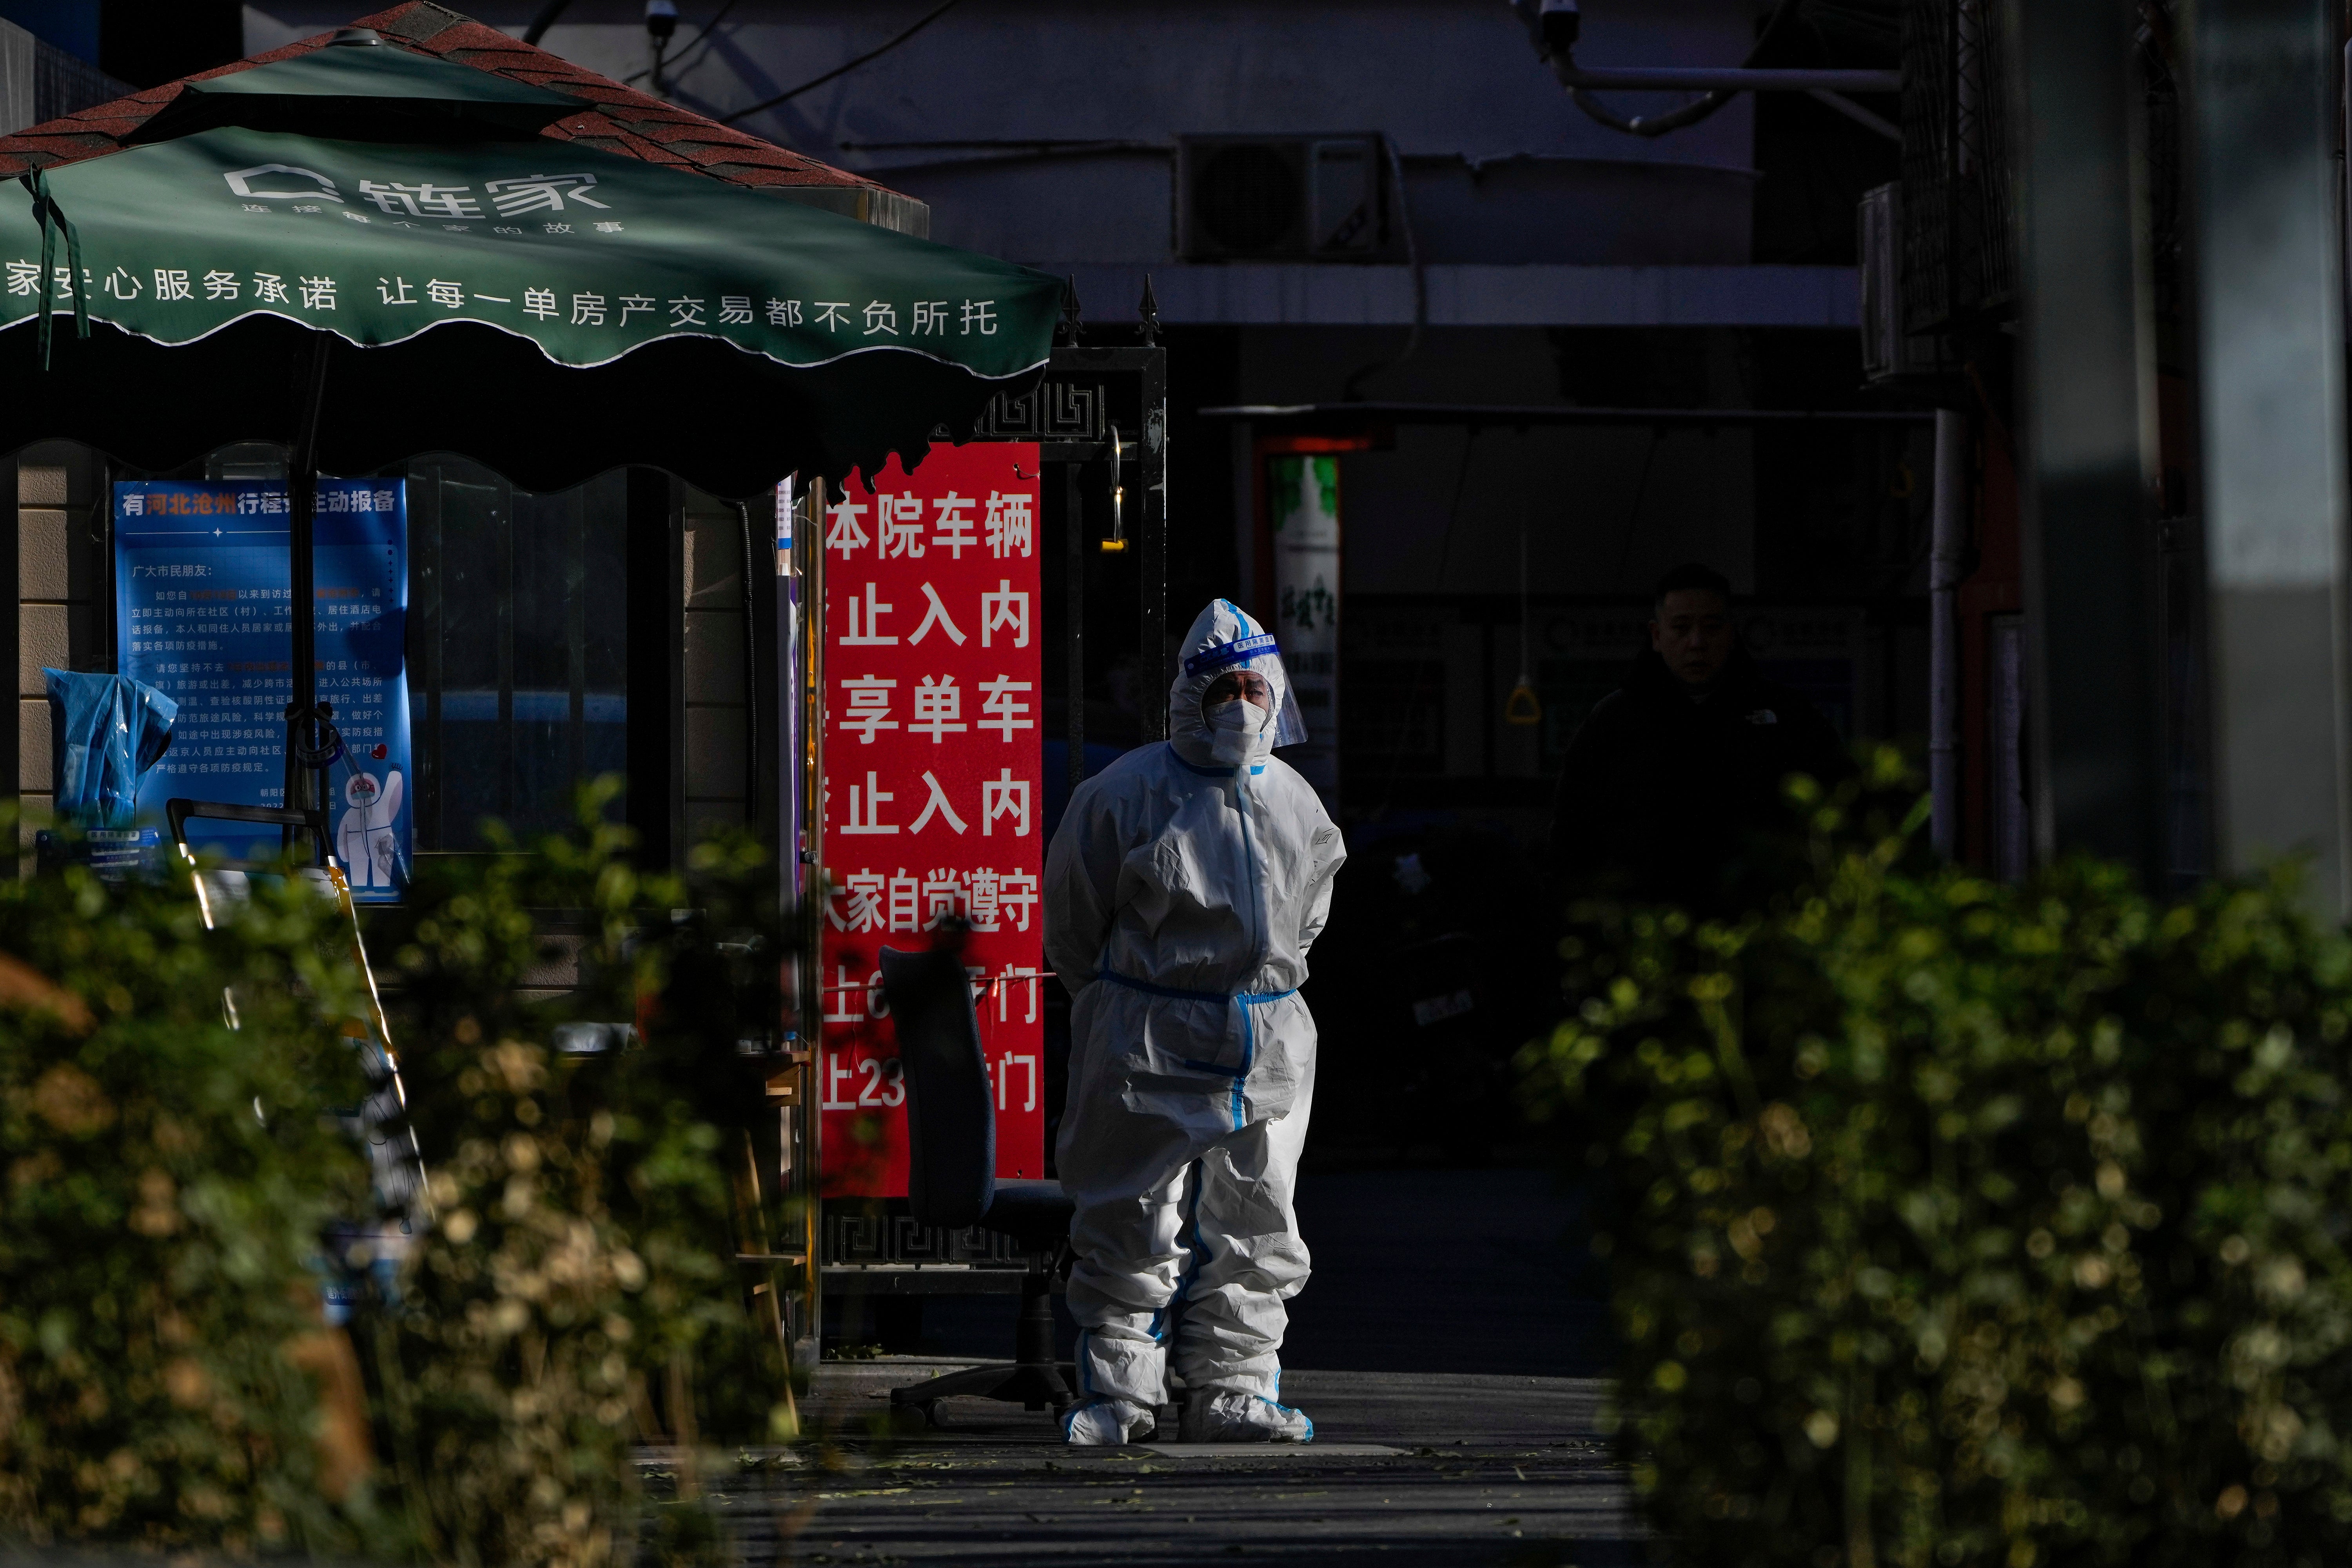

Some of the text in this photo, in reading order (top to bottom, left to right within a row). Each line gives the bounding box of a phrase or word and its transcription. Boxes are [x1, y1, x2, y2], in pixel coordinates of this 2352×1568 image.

[241, 203, 624, 234] 连接每个家的故事
[358, 173, 612, 218] 链家
[376, 276, 998, 336] 让每一单房产交易都不负所托
[826, 580, 1029, 648] 止入内
[823, 674, 1034, 744] 享单车
[825, 768, 1030, 837] 止入内
